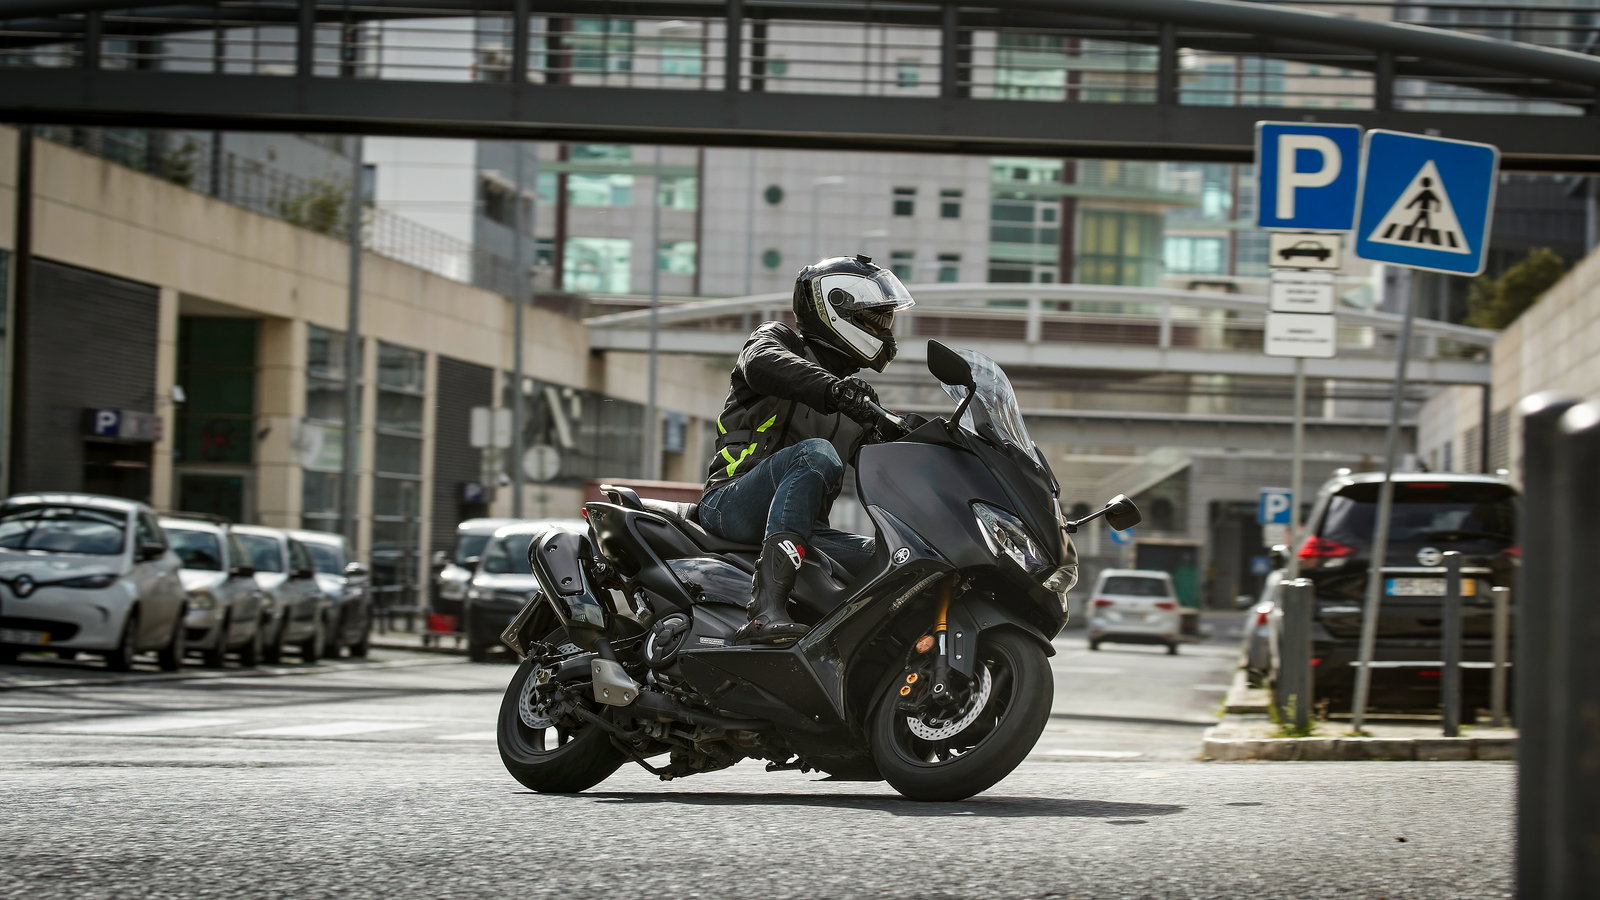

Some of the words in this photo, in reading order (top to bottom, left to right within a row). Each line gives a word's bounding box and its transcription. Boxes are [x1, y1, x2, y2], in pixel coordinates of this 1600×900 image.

[1276, 134, 1342, 220] P
[813, 280, 827, 318] SHARK
[95, 411, 118, 435] P
[1264, 494, 1289, 522] P
